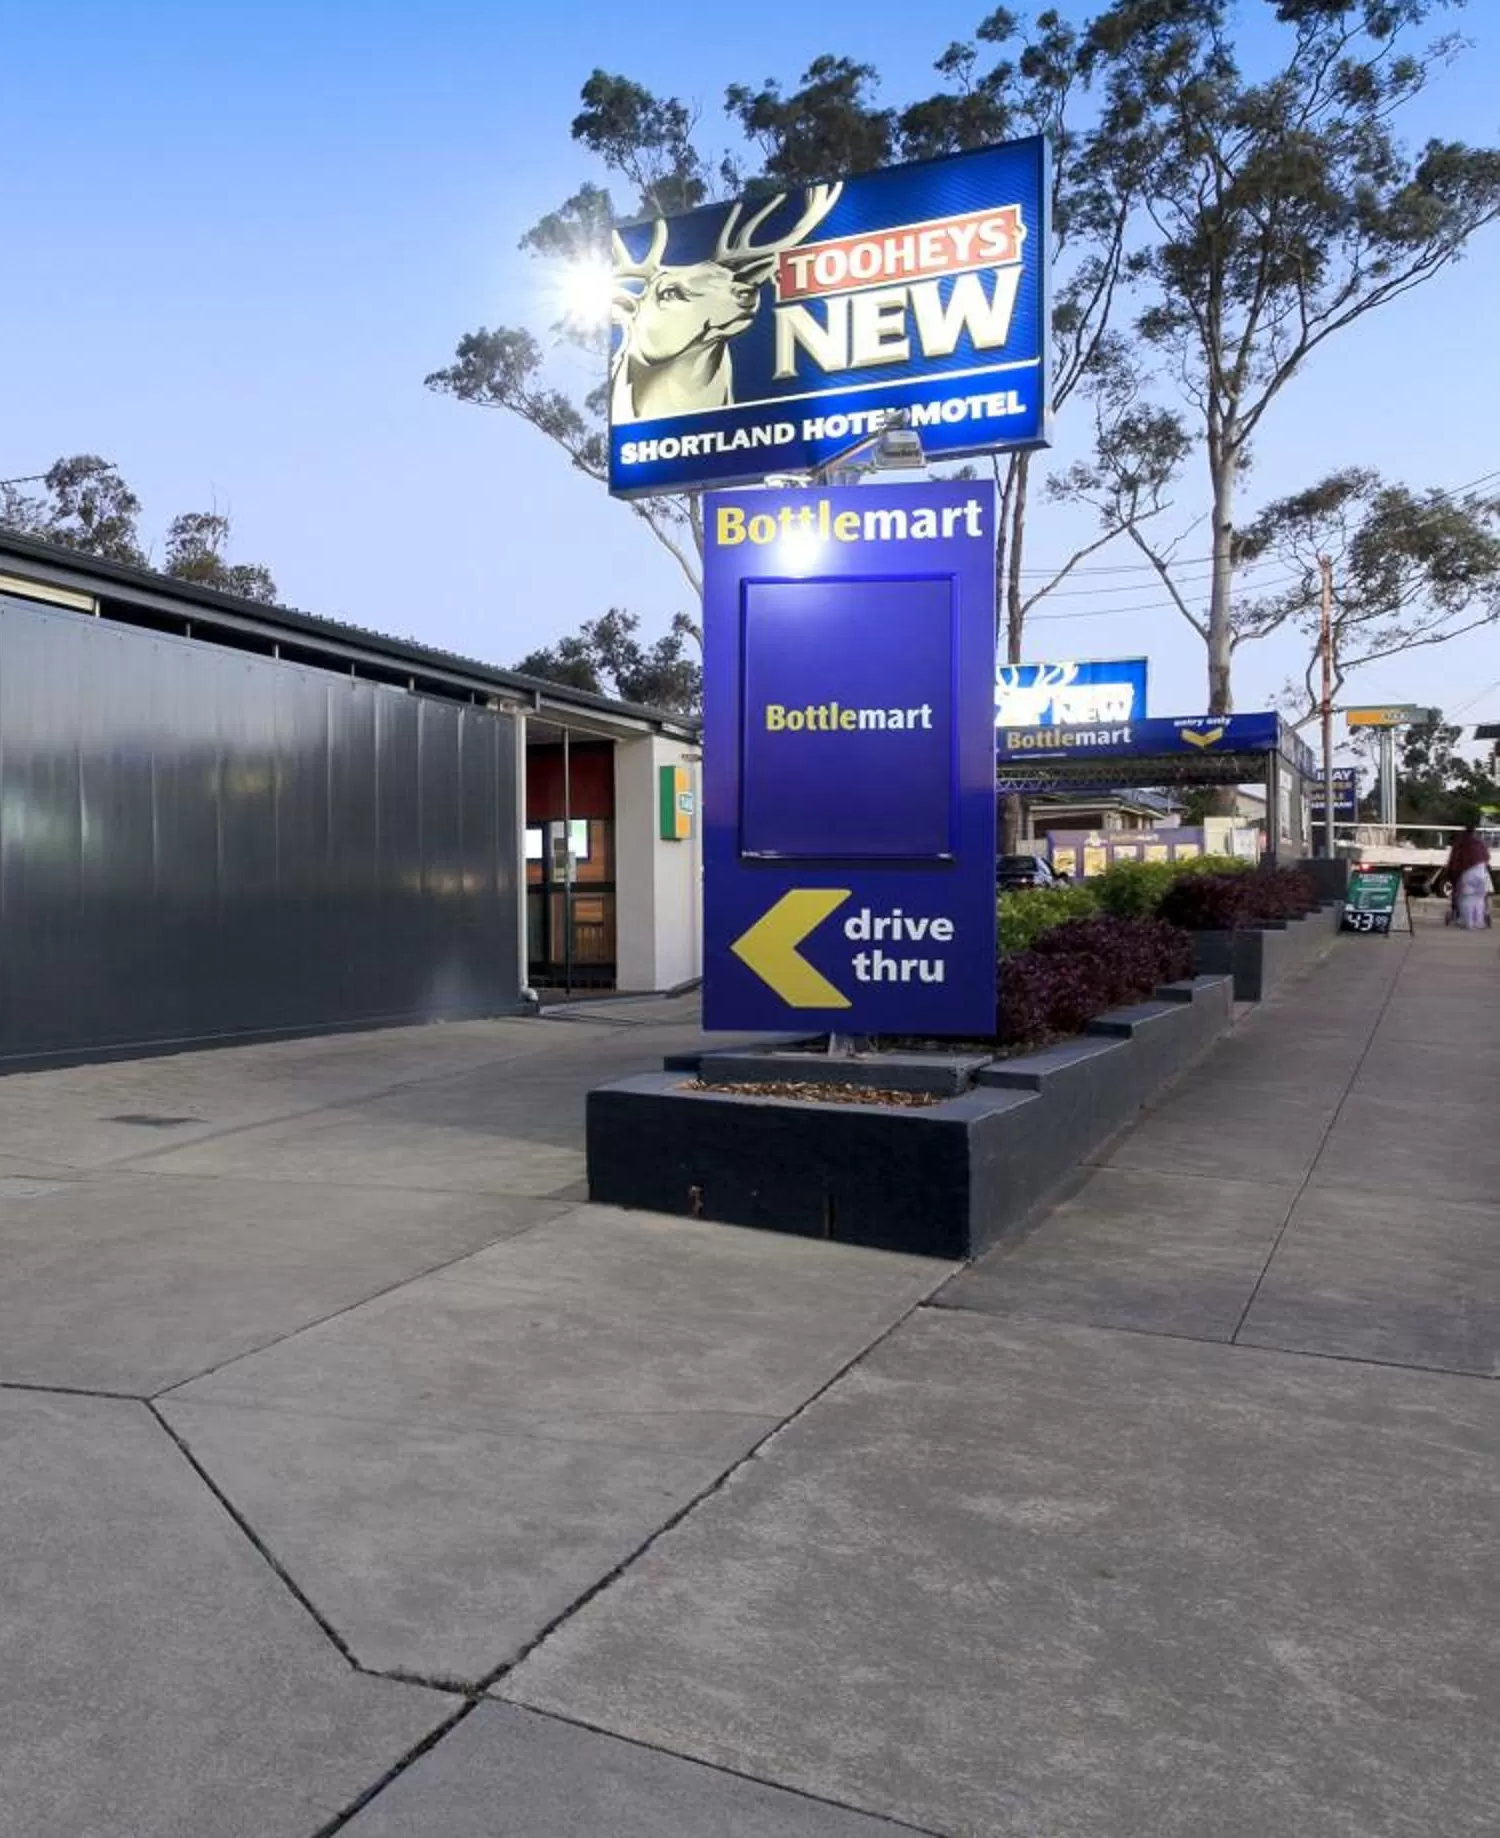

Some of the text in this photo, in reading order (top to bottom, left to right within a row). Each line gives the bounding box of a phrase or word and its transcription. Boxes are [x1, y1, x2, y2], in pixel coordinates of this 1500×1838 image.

[788, 217, 1012, 289] TOOHEYS
[772, 265, 1024, 379] NEW
[621, 390, 1026, 464] SHORTLAND HOTE MOTEL
[717, 500, 982, 544] Bottlemart
[766, 701, 933, 731] Bottlemart
[1207, 715, 1232, 727] only
[1007, 727, 1132, 749] Bottlemart
[844, 908, 954, 942] drive
[852, 949, 945, 982] thru
